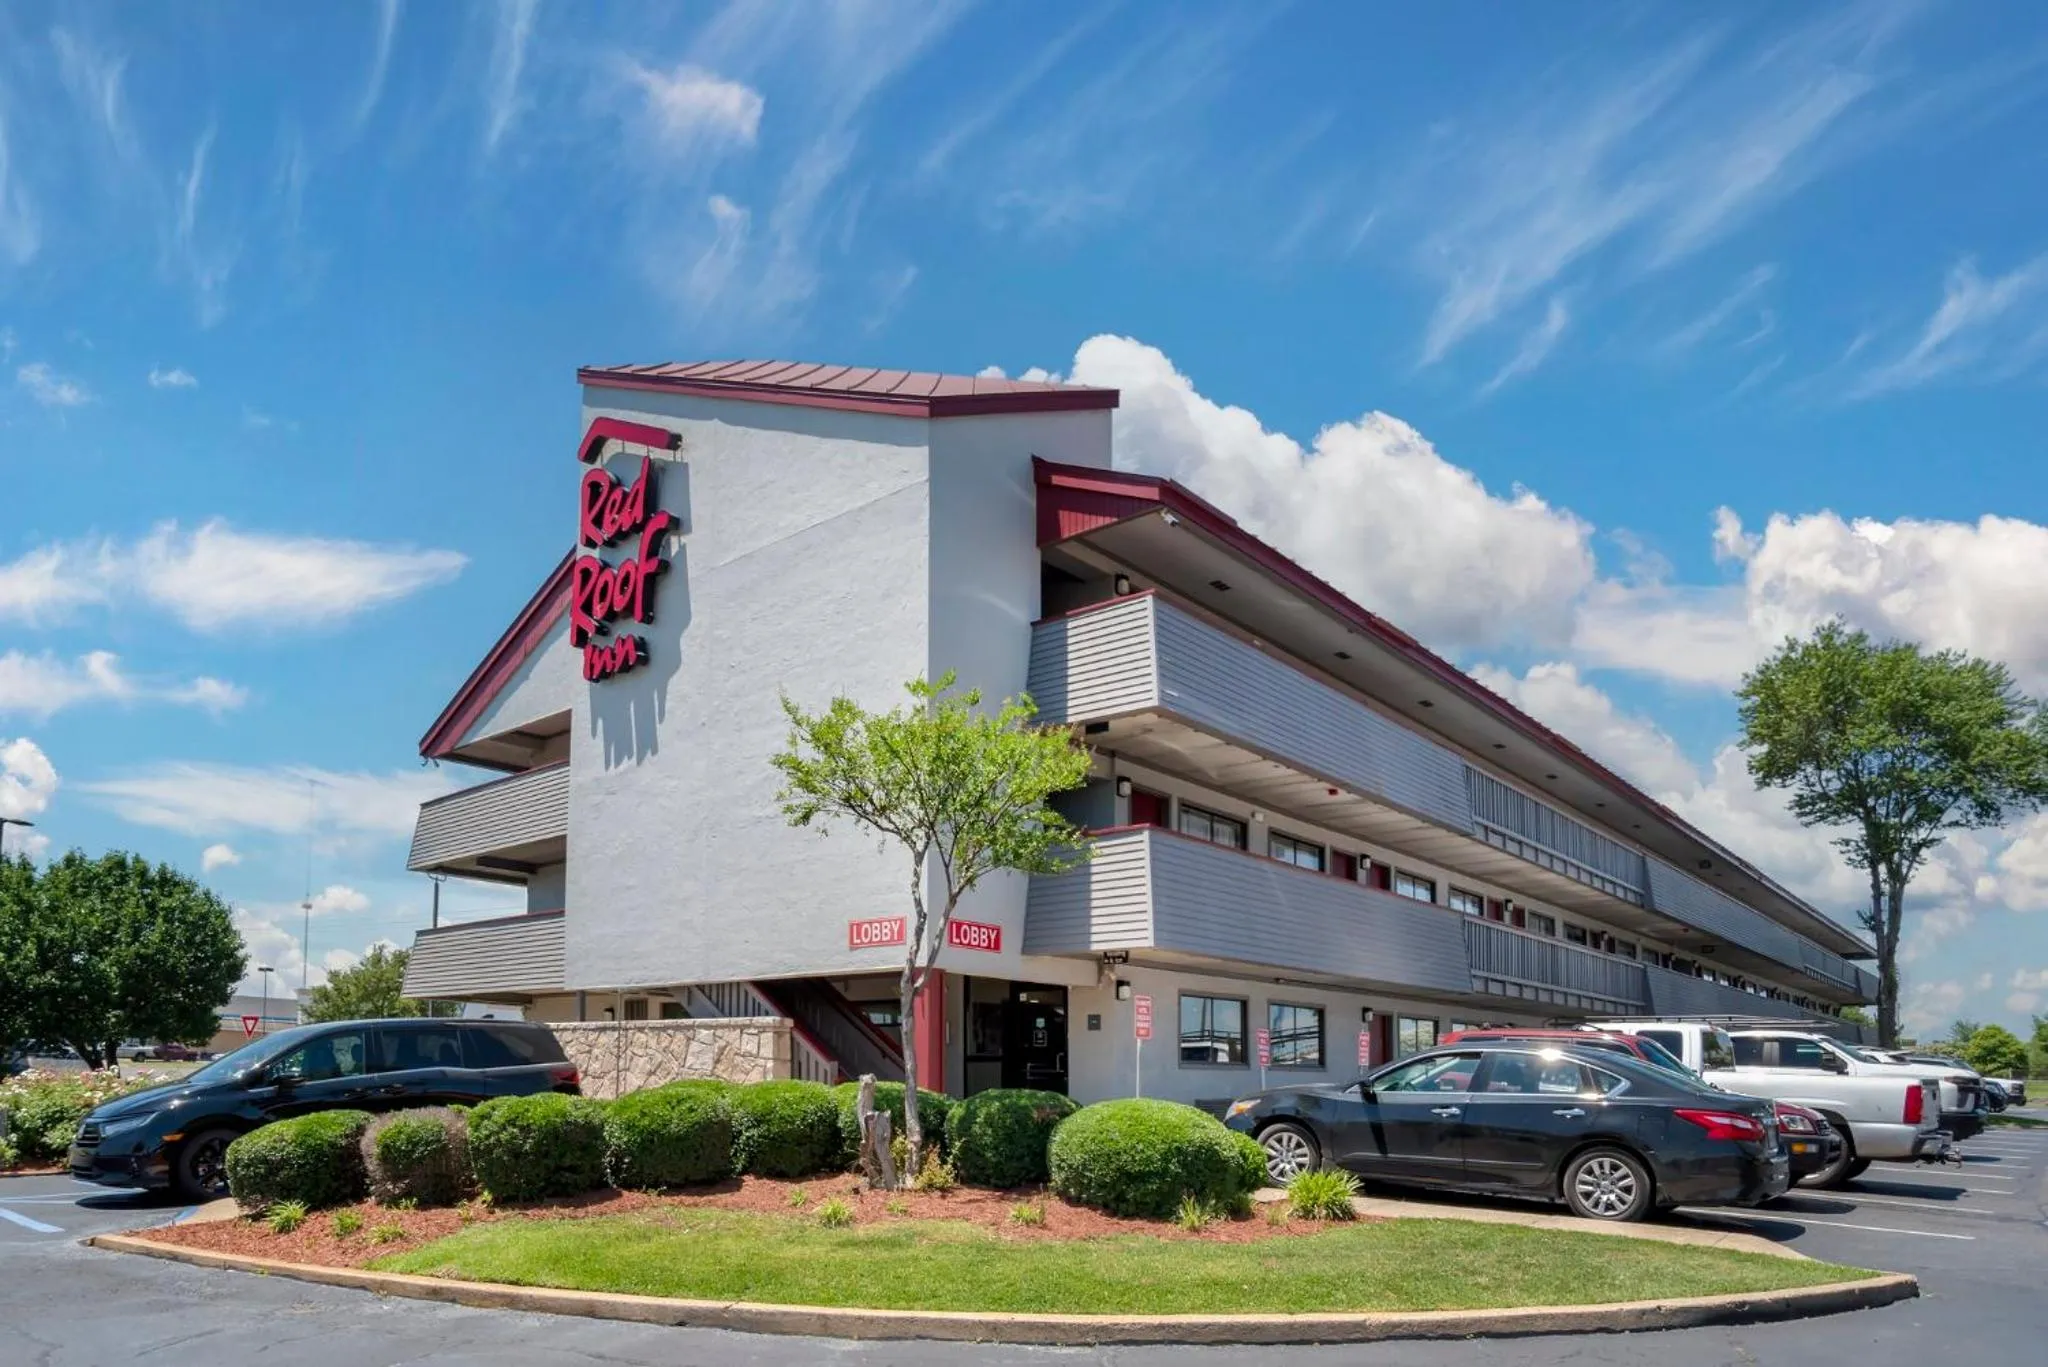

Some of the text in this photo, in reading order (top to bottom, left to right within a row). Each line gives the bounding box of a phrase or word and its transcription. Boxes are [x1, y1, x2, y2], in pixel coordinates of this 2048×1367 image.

[581, 455, 652, 547] Red
[571, 510, 673, 648] Roof
[853, 920, 901, 944] LOBBY
[952, 922, 998, 948] LOBBY
